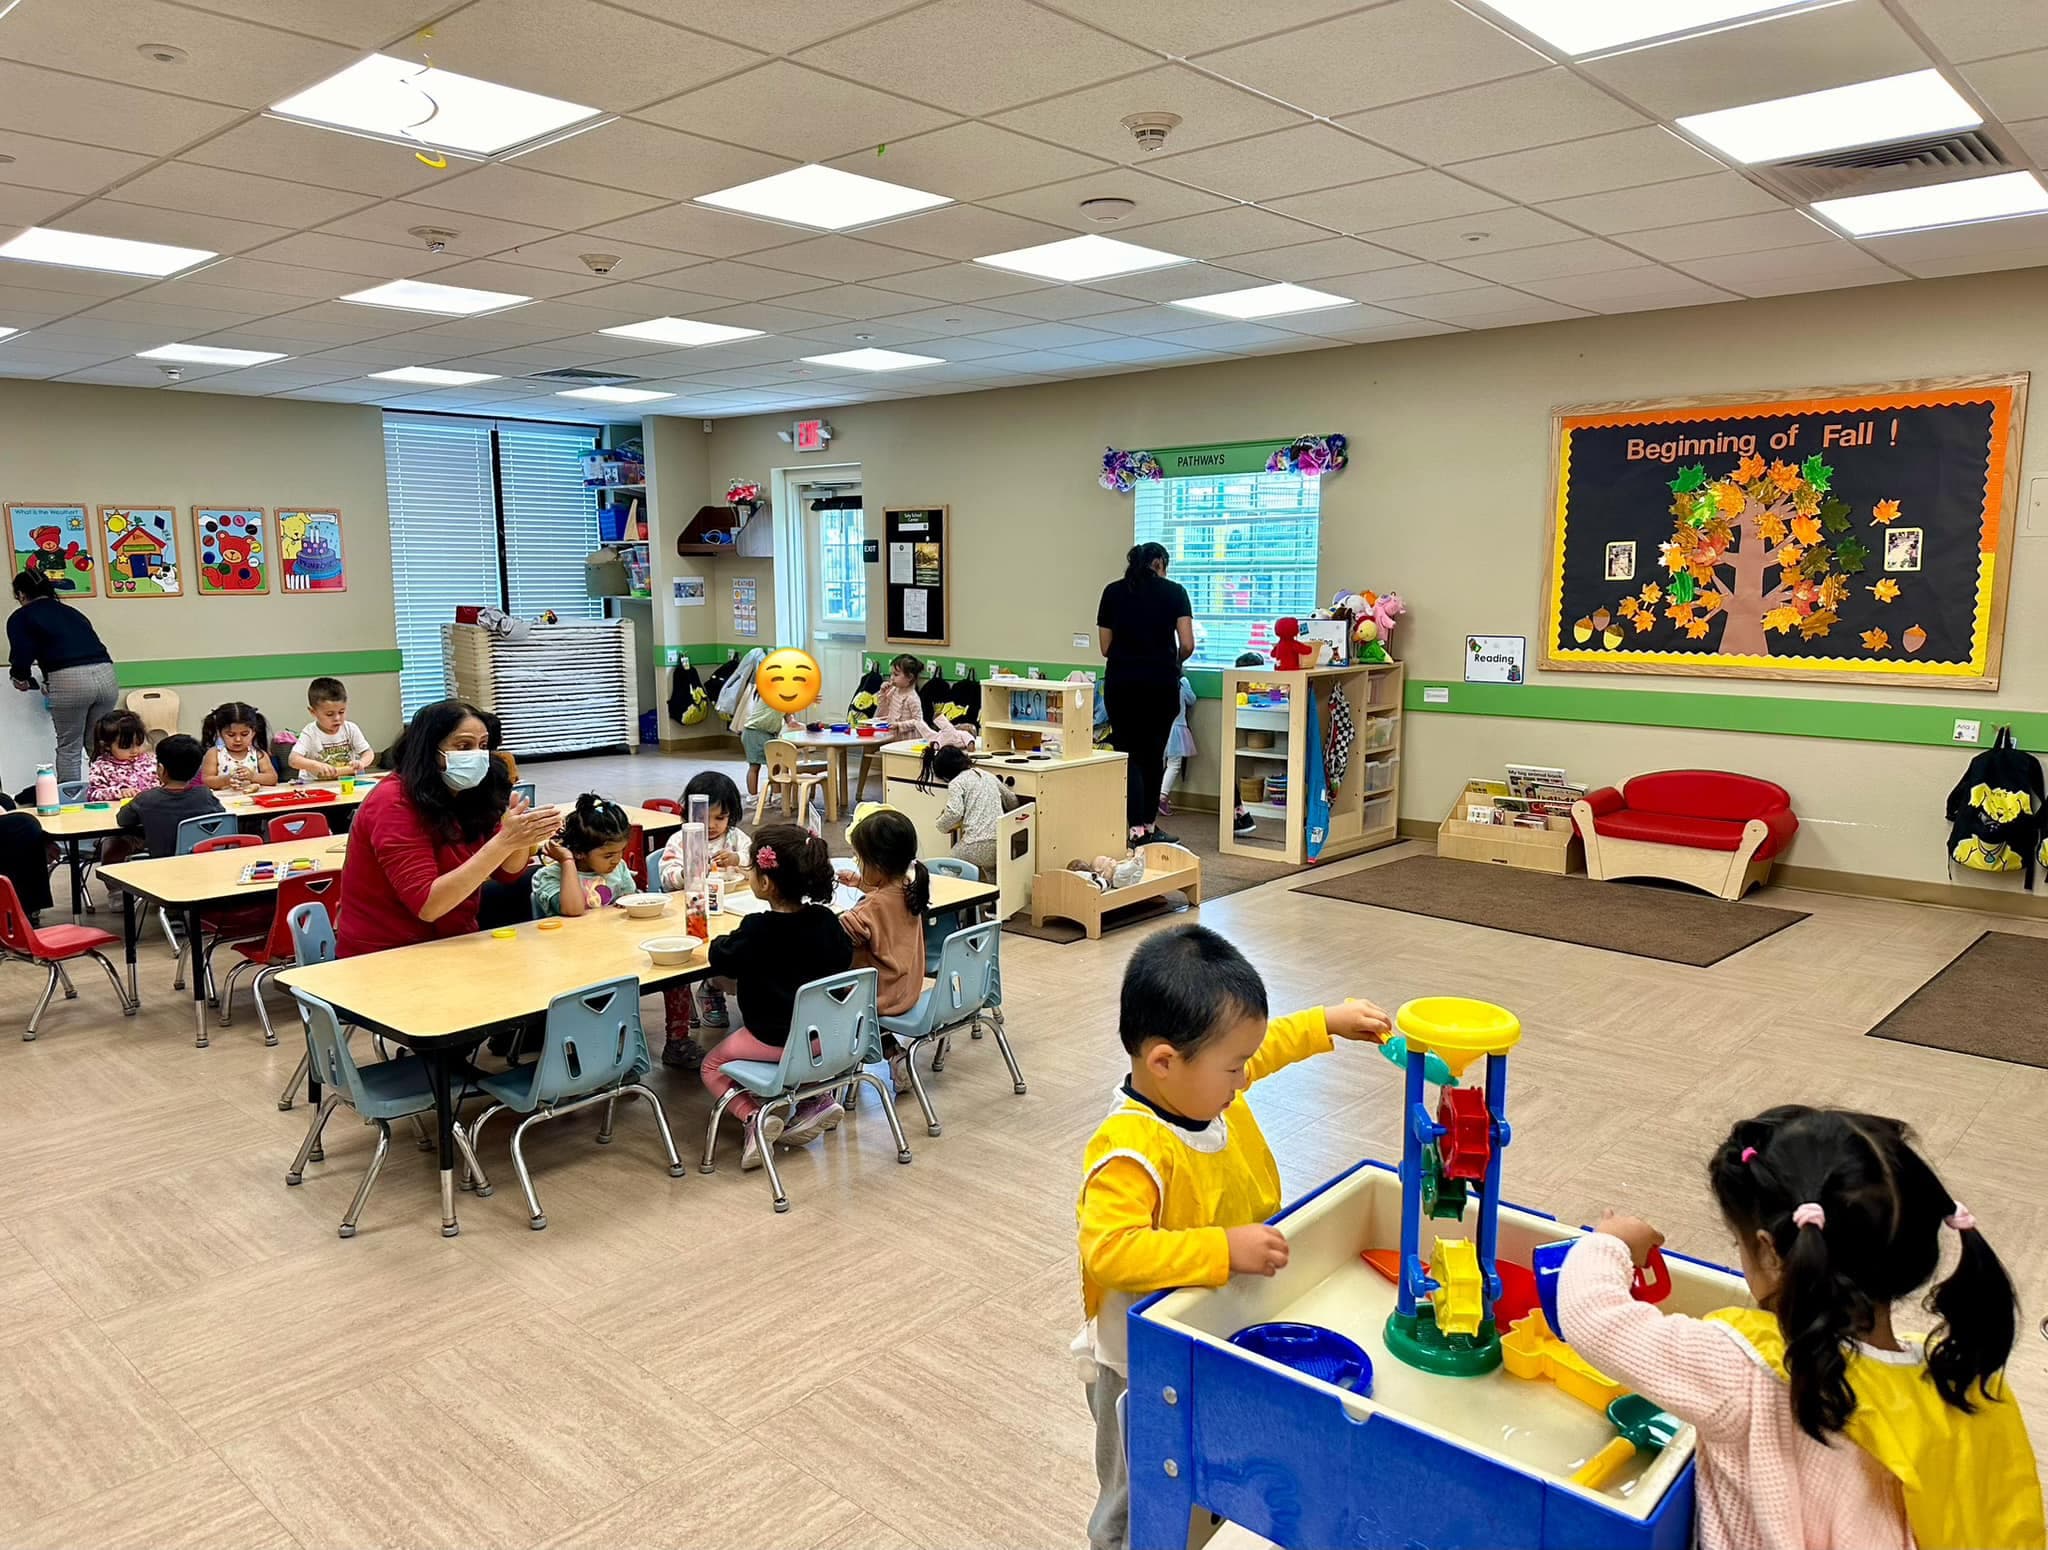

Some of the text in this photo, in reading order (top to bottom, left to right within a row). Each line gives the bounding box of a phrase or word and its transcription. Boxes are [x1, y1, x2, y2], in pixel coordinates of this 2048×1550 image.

[1626, 431, 1756, 463] Beginning
[1769, 423, 1799, 450] of
[1822, 421, 1874, 448] Fall
[1177, 453, 1225, 468] PATHWAYS
[863, 545, 877, 553] EXIT
[1474, 652, 1515, 665] Reading
